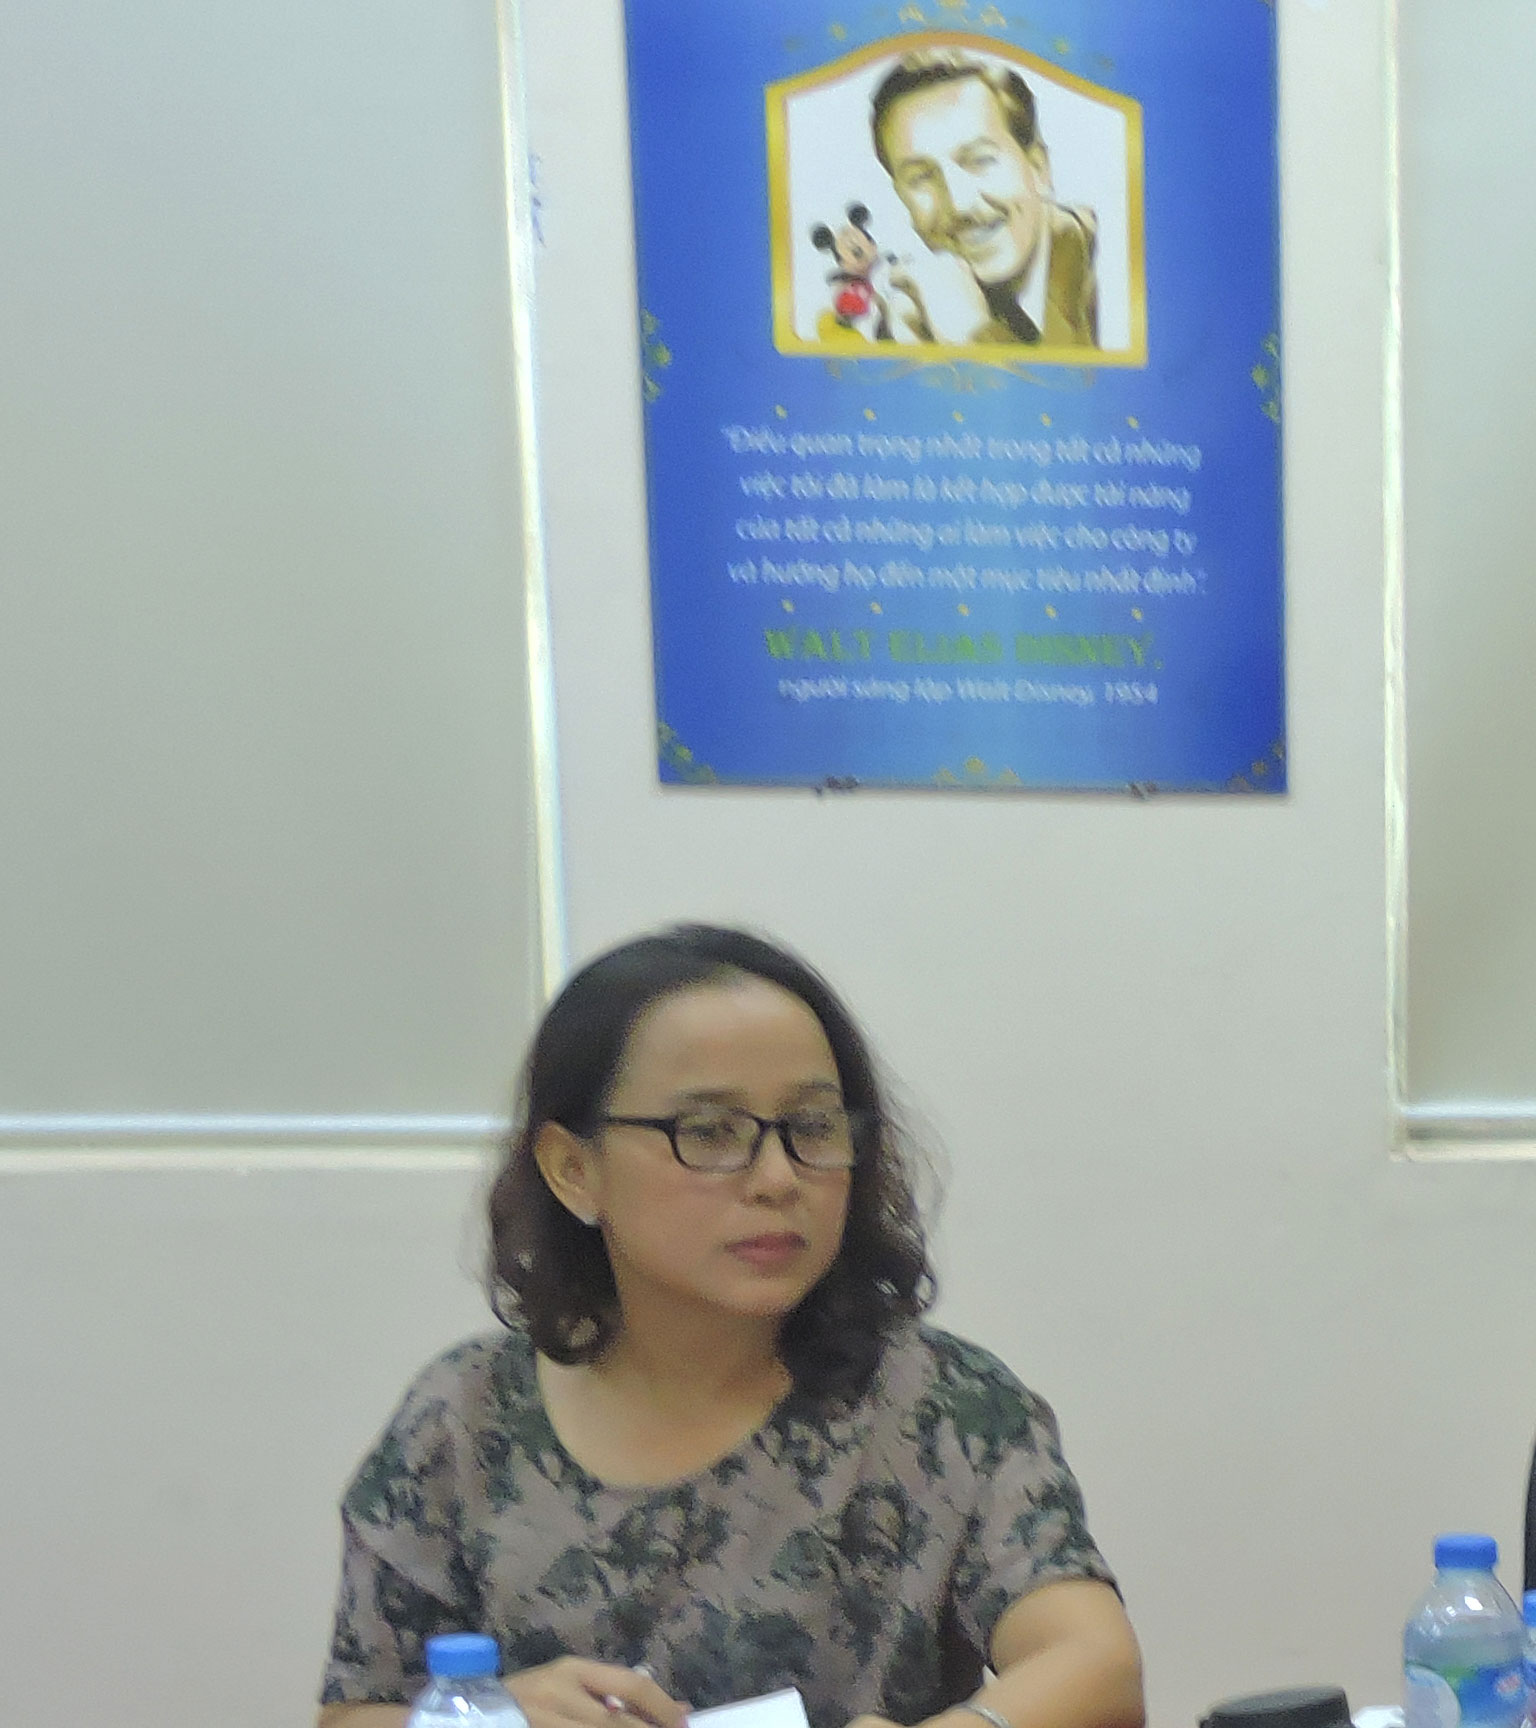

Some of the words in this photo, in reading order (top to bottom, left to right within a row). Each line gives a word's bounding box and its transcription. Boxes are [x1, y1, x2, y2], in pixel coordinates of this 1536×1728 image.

[764, 628, 873, 662] WALT
[956, 678, 1010, 702] Walt
[1105, 681, 1158, 705] 1954
